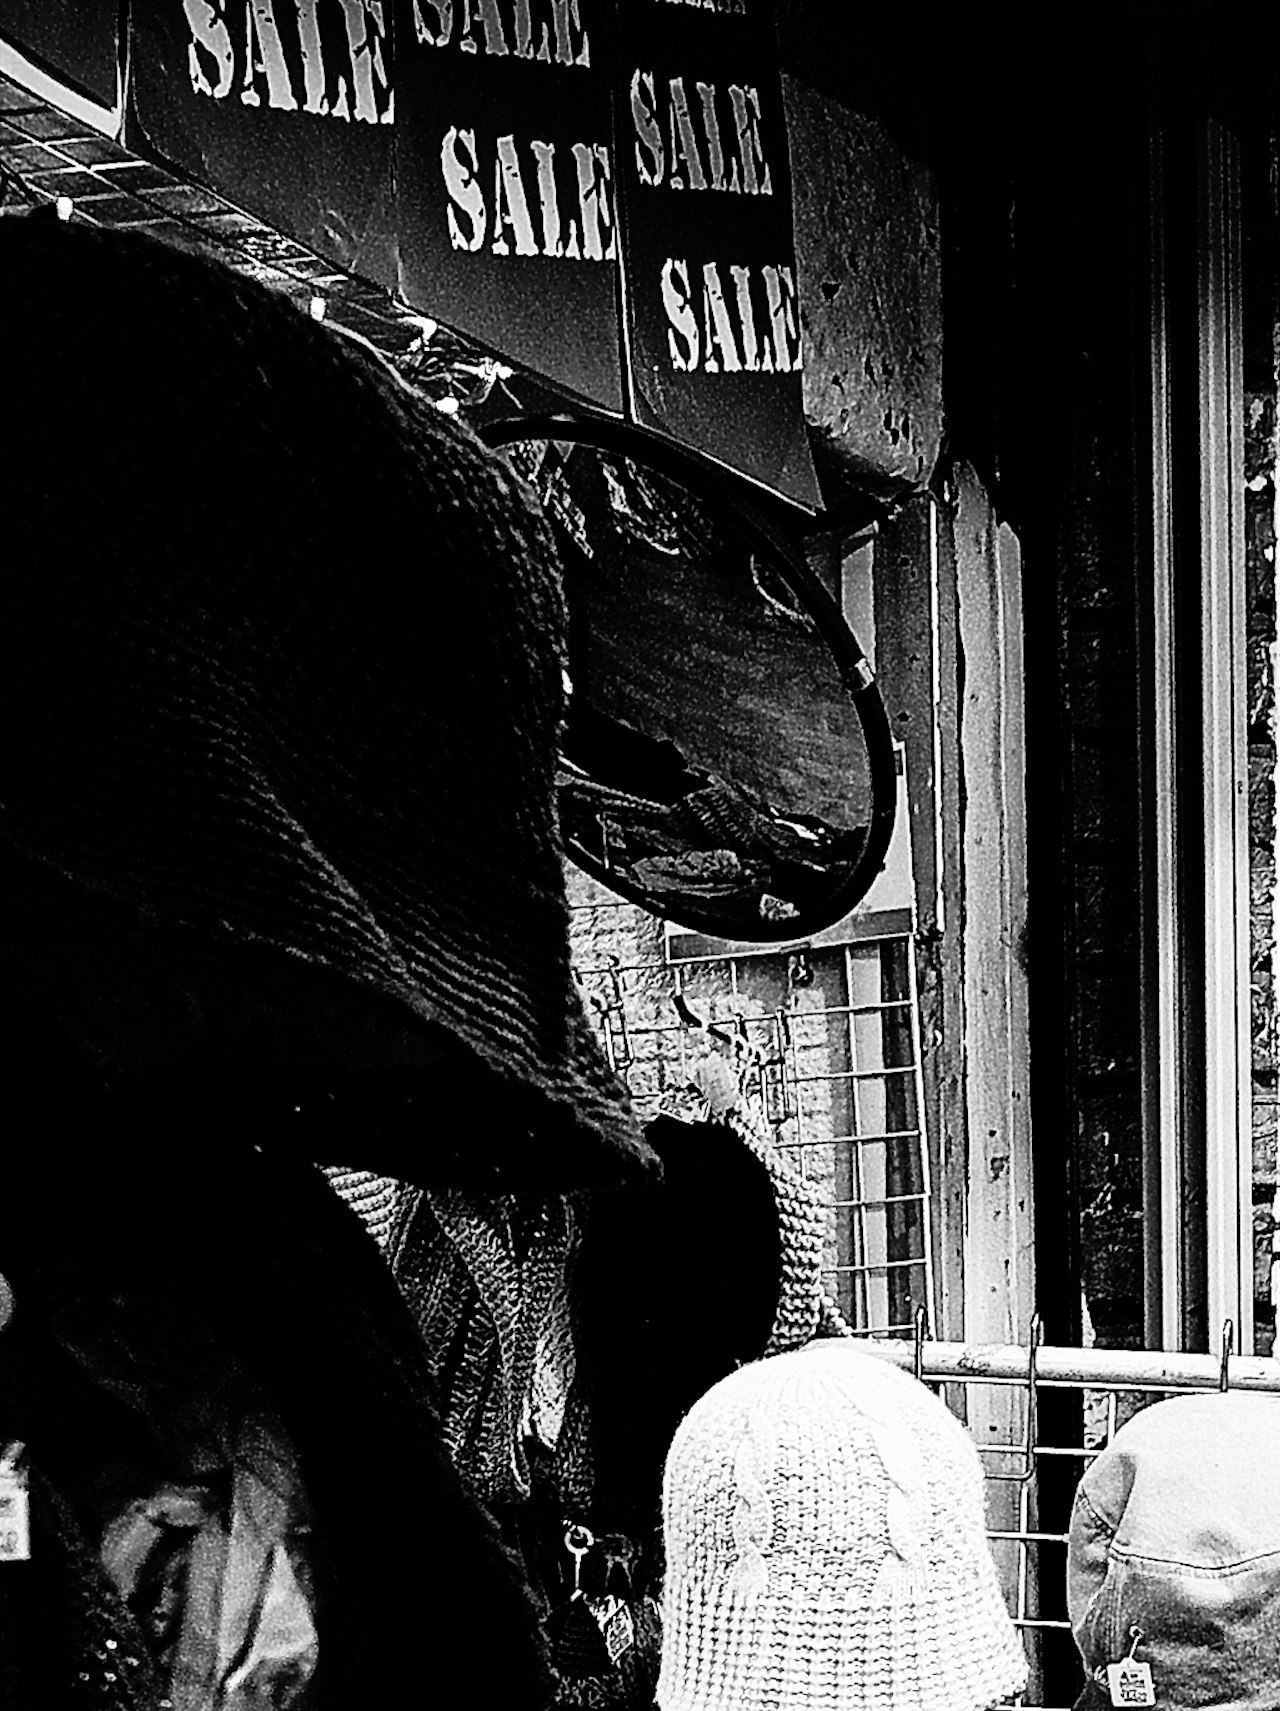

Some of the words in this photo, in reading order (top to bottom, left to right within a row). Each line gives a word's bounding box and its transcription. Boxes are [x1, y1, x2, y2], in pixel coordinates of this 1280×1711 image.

[441, 126, 616, 260] SALE
[631, 68, 773, 195] SALE
[661, 258, 803, 374] SALE
